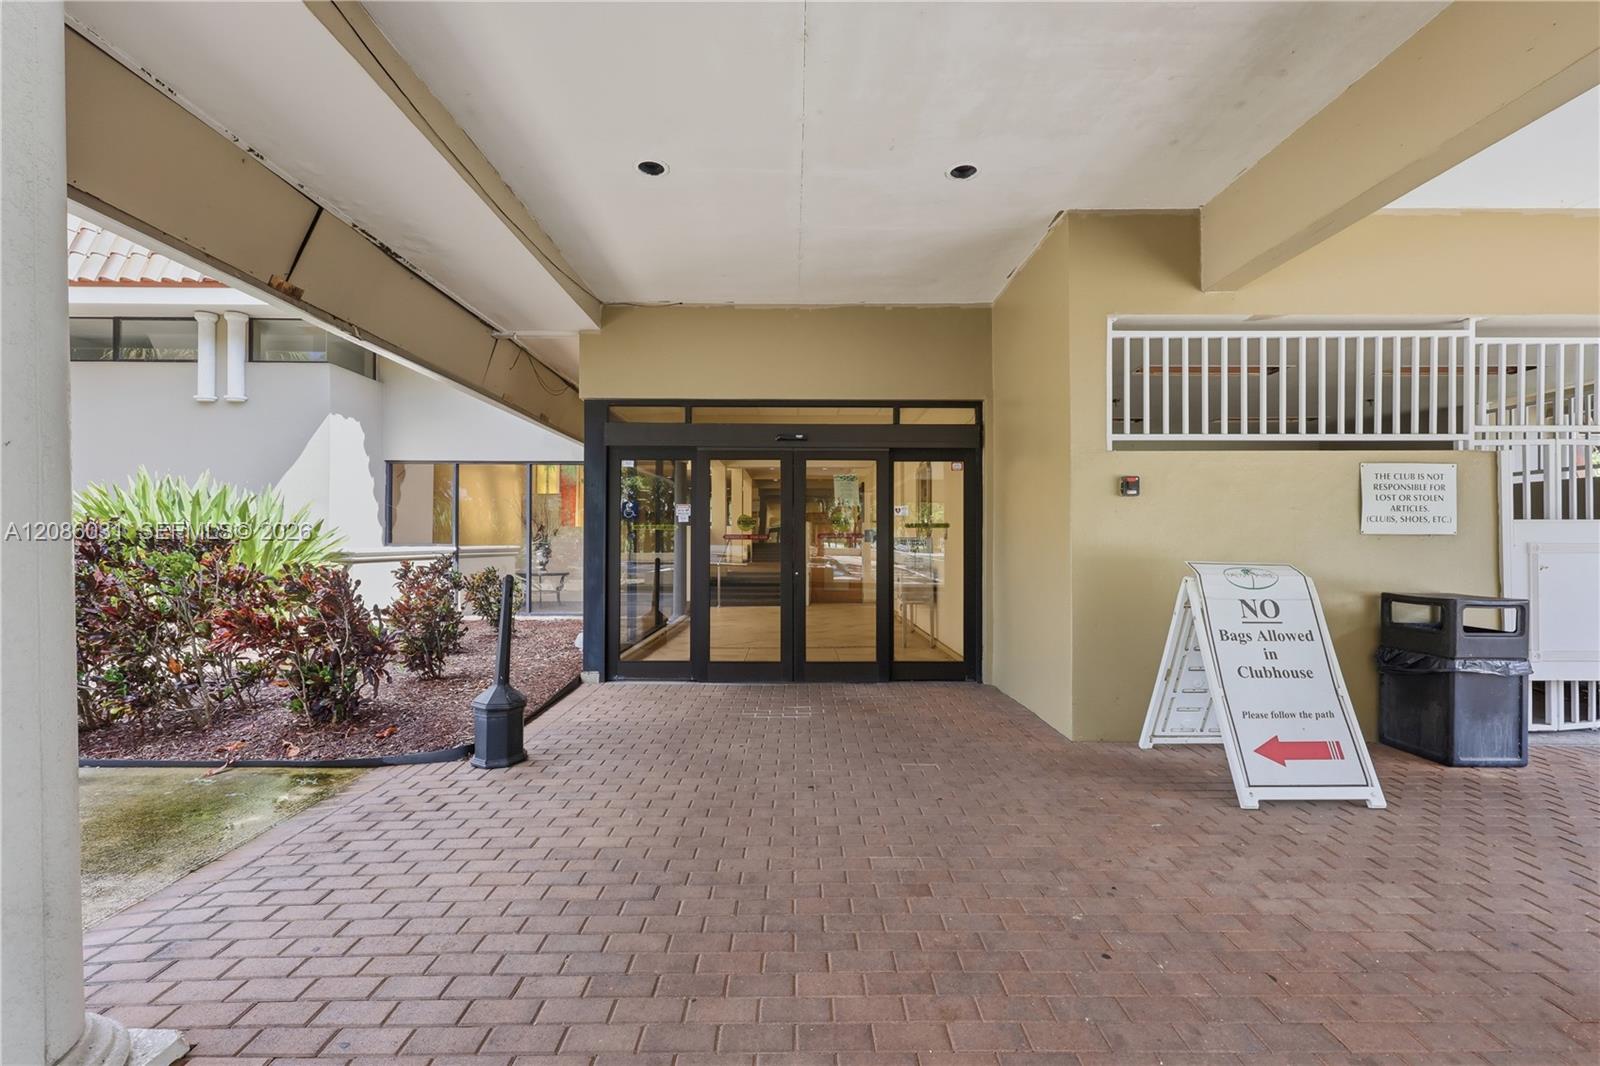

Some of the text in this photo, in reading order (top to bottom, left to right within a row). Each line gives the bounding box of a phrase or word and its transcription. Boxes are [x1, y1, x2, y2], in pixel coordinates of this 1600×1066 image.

[1427, 473, 1444, 481] NOT
[1375, 494, 1444, 502] LOST OR STOLEN
[1400, 515, 1431, 524] SHOES,
[1432, 515, 1452, 524] ETC.)
[1239, 599, 1280, 619] NO
[1218, 629, 1314, 644] Bags Allowed
[1264, 648, 1278, 660] in
[1237, 666, 1314, 679] Clubhouse
[1242, 710, 1335, 721] Please follow the path
